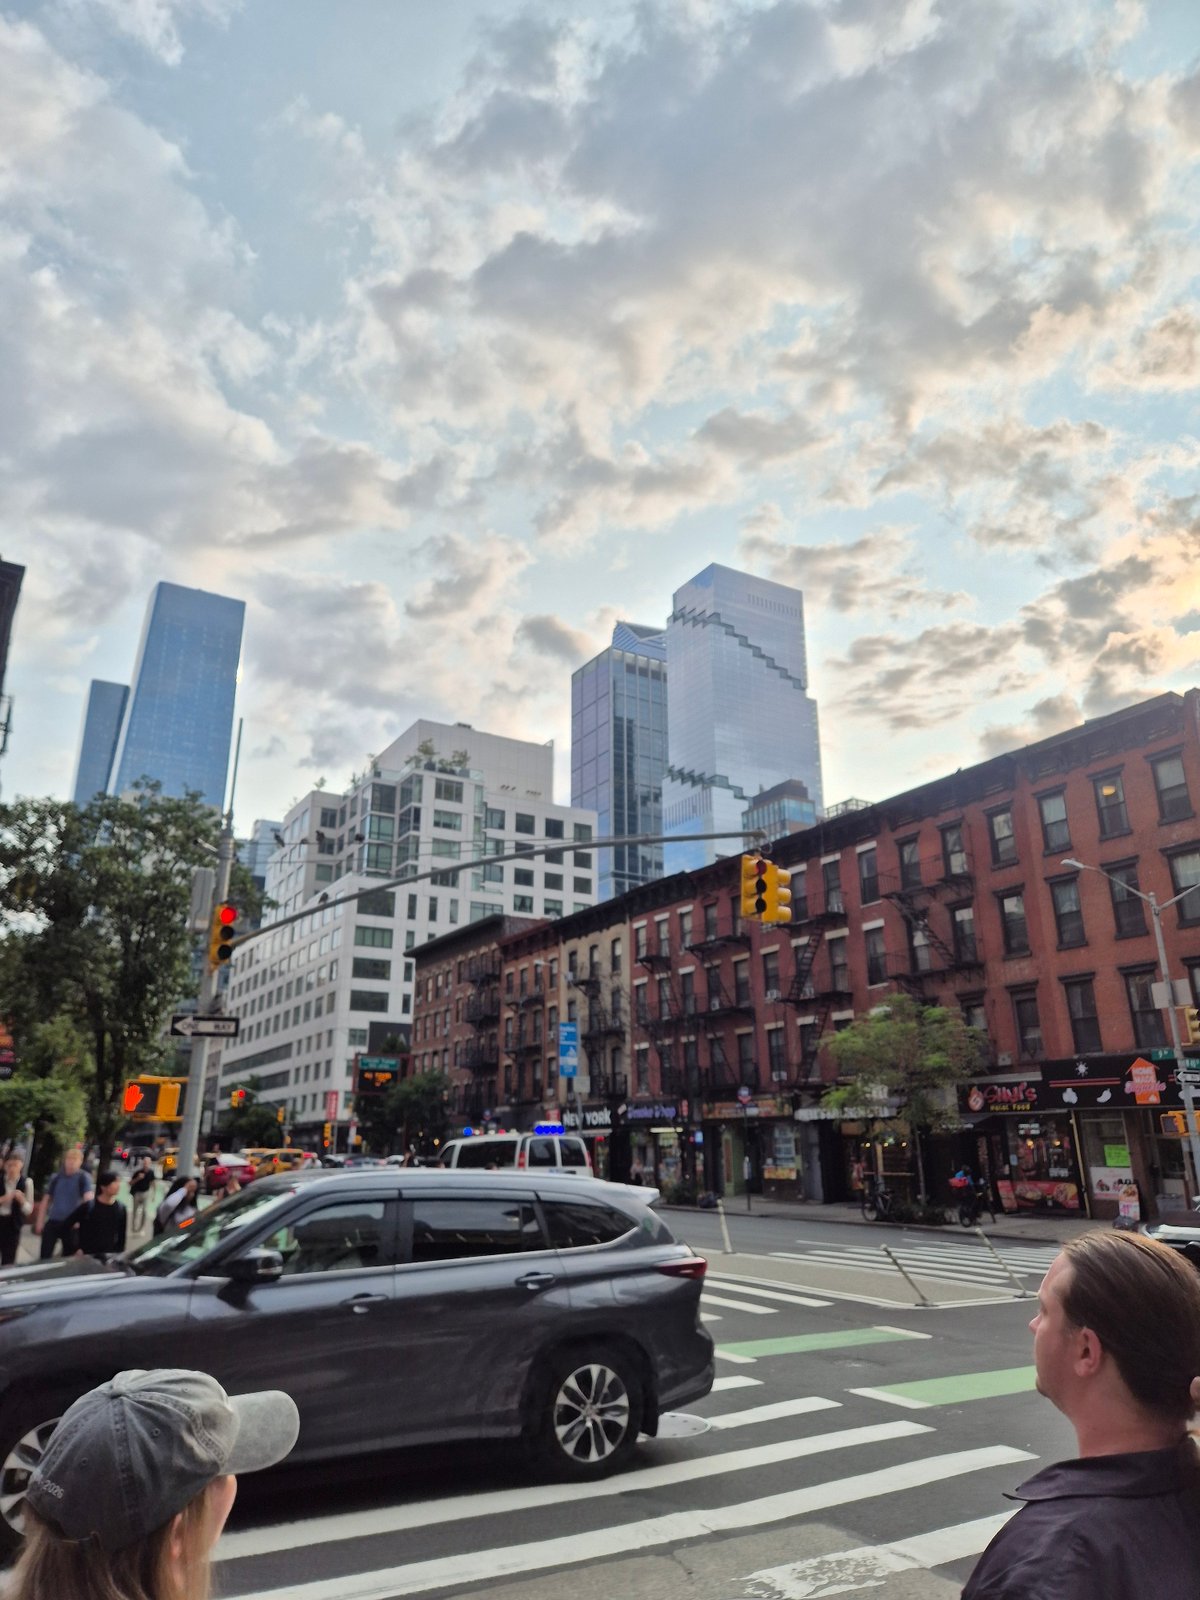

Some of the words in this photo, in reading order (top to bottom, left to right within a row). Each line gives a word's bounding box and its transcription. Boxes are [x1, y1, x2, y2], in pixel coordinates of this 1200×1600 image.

[214, 1022, 233, 1031] WAY
[562, 1108, 584, 1127] NEW
[585, 1106, 612, 1125] YORK
